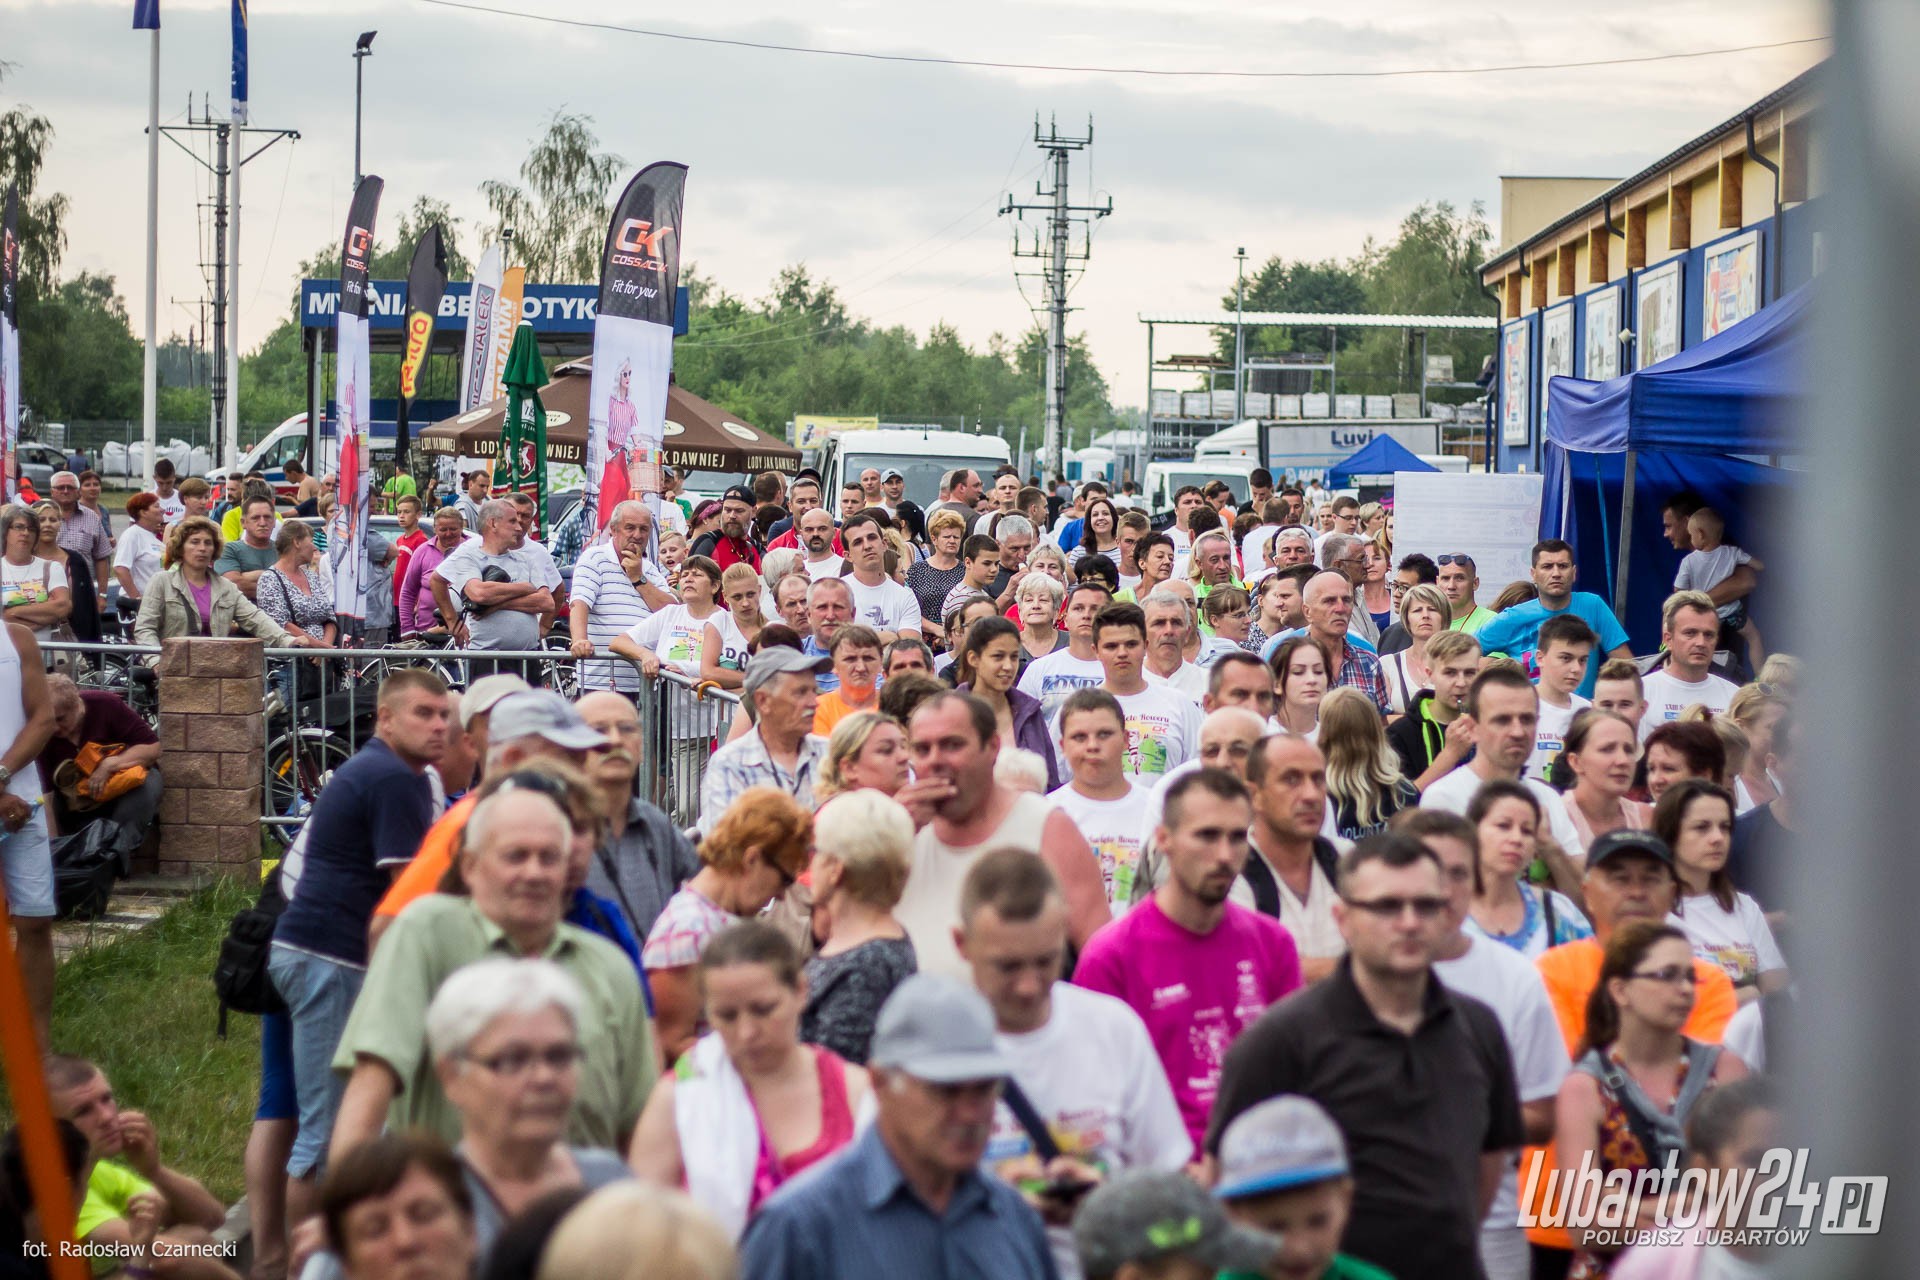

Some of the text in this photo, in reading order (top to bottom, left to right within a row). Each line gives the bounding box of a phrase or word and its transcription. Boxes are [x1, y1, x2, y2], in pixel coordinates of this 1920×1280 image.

[611, 279, 658, 300] Fit for you
[546, 443, 580, 460] WNIEJ
[672, 451, 725, 468] DAWNIEJ
[747, 455, 798, 472] LODY JAK DAWNIEJ
